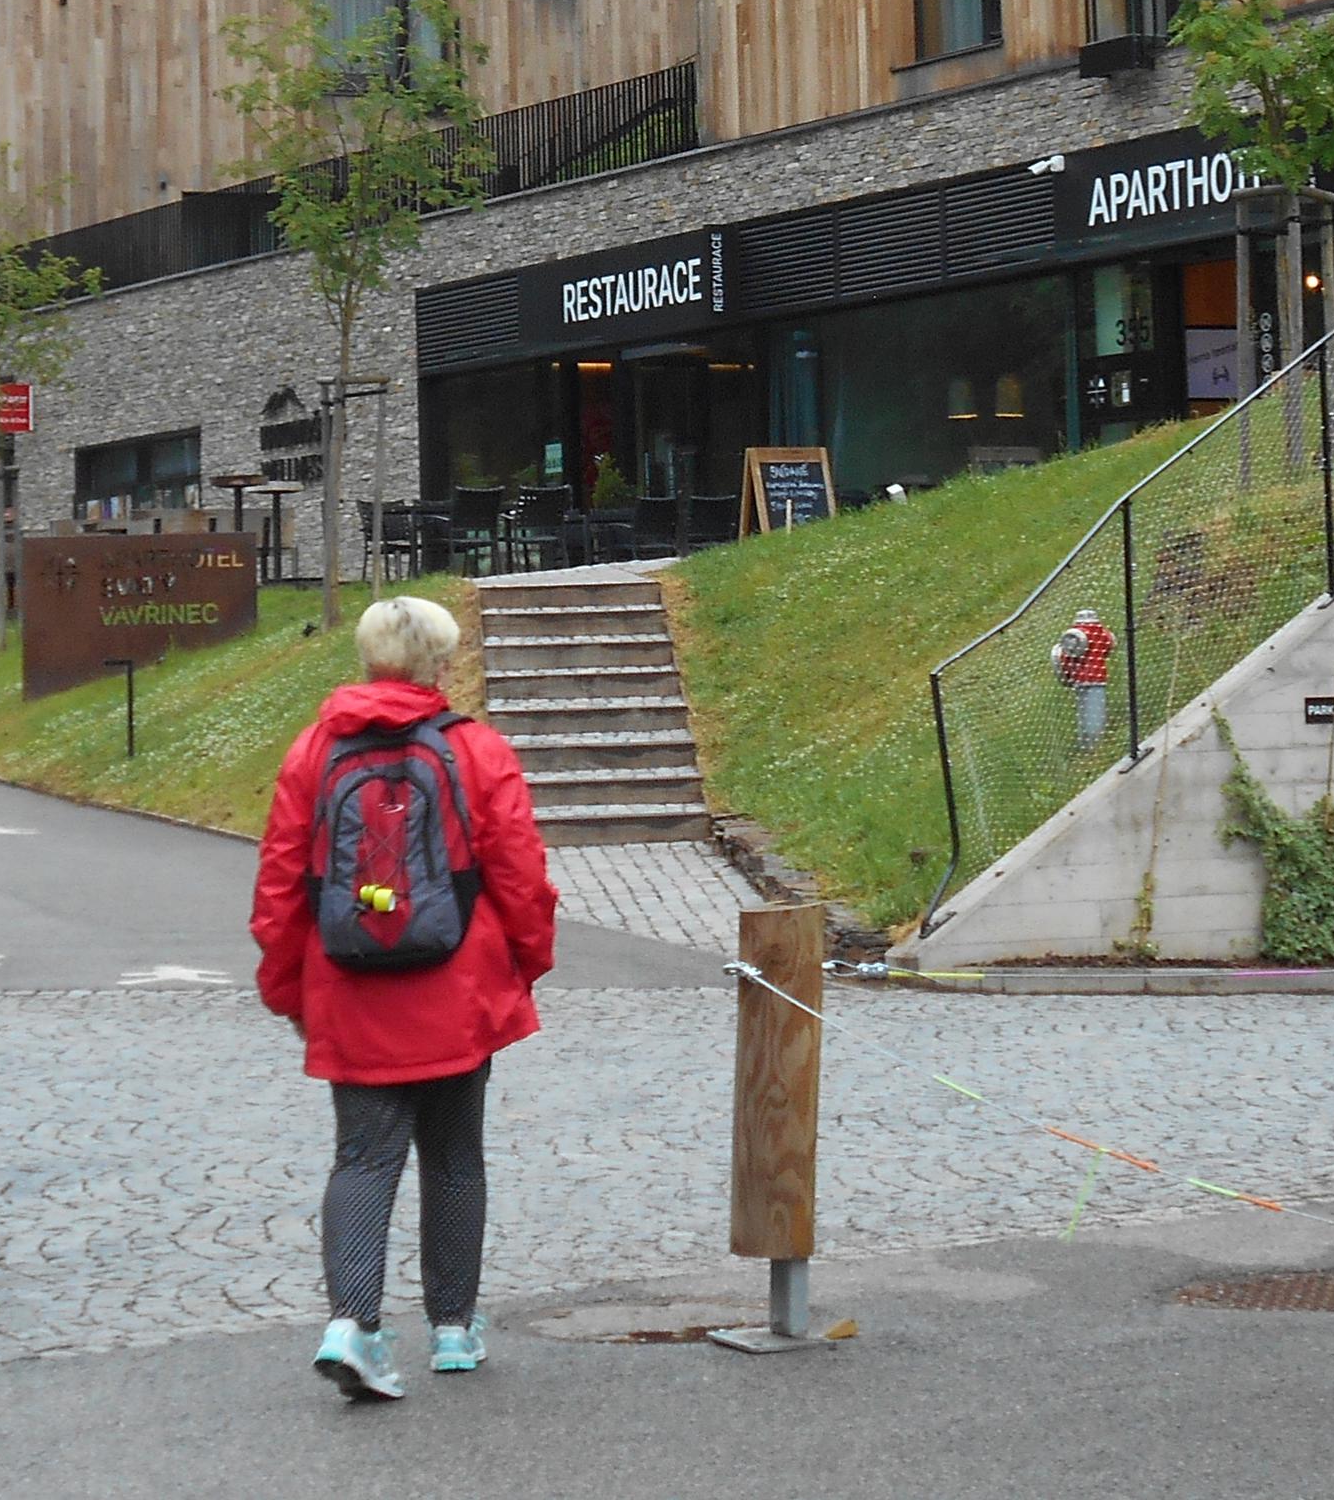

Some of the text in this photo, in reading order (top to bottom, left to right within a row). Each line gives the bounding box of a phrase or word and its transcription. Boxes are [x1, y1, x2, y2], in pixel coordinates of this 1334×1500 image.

[1087, 150, 1264, 227] APARTHO
[562, 257, 704, 324] RESTAURACE
[710, 232, 725, 313] RESTAURACE
[98, 599, 220, 627] VAVŘINEC
